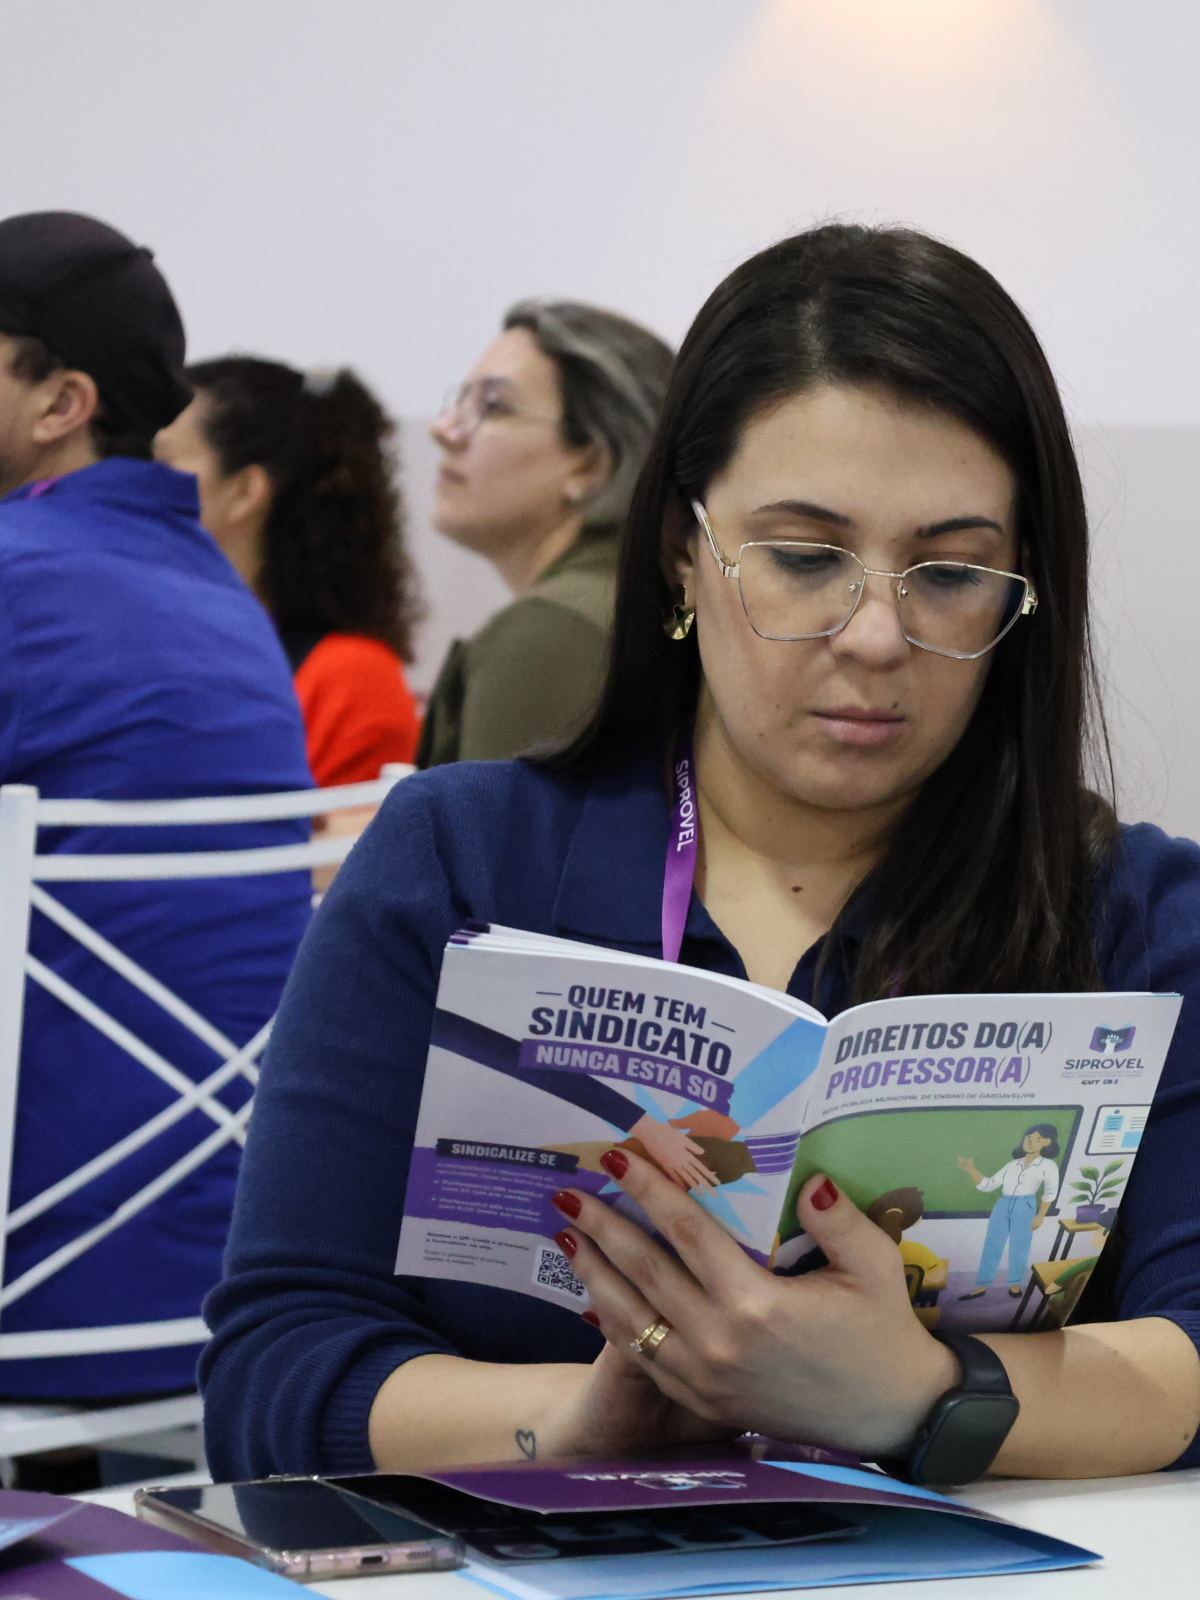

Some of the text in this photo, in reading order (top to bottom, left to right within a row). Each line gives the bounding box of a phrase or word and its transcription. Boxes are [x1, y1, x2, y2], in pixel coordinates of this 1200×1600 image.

[675, 759, 695, 852] SIPROVEL
[567, 984, 707, 1029] QUEM TEM
[528, 1006, 732, 1076] SINDICATO
[834, 1021, 1053, 1065] DIREITOS DO(A)
[535, 1045, 718, 1103] NUNCA ESTÁ SÓ
[825, 1056, 1031, 1100] PROFESSOR(A)
[1063, 1058, 1145, 1070] SIPROVEL
[875, 1094, 919, 1103] MUNICIPAL
[451, 1143, 557, 1166] SINDICALIZE SE
